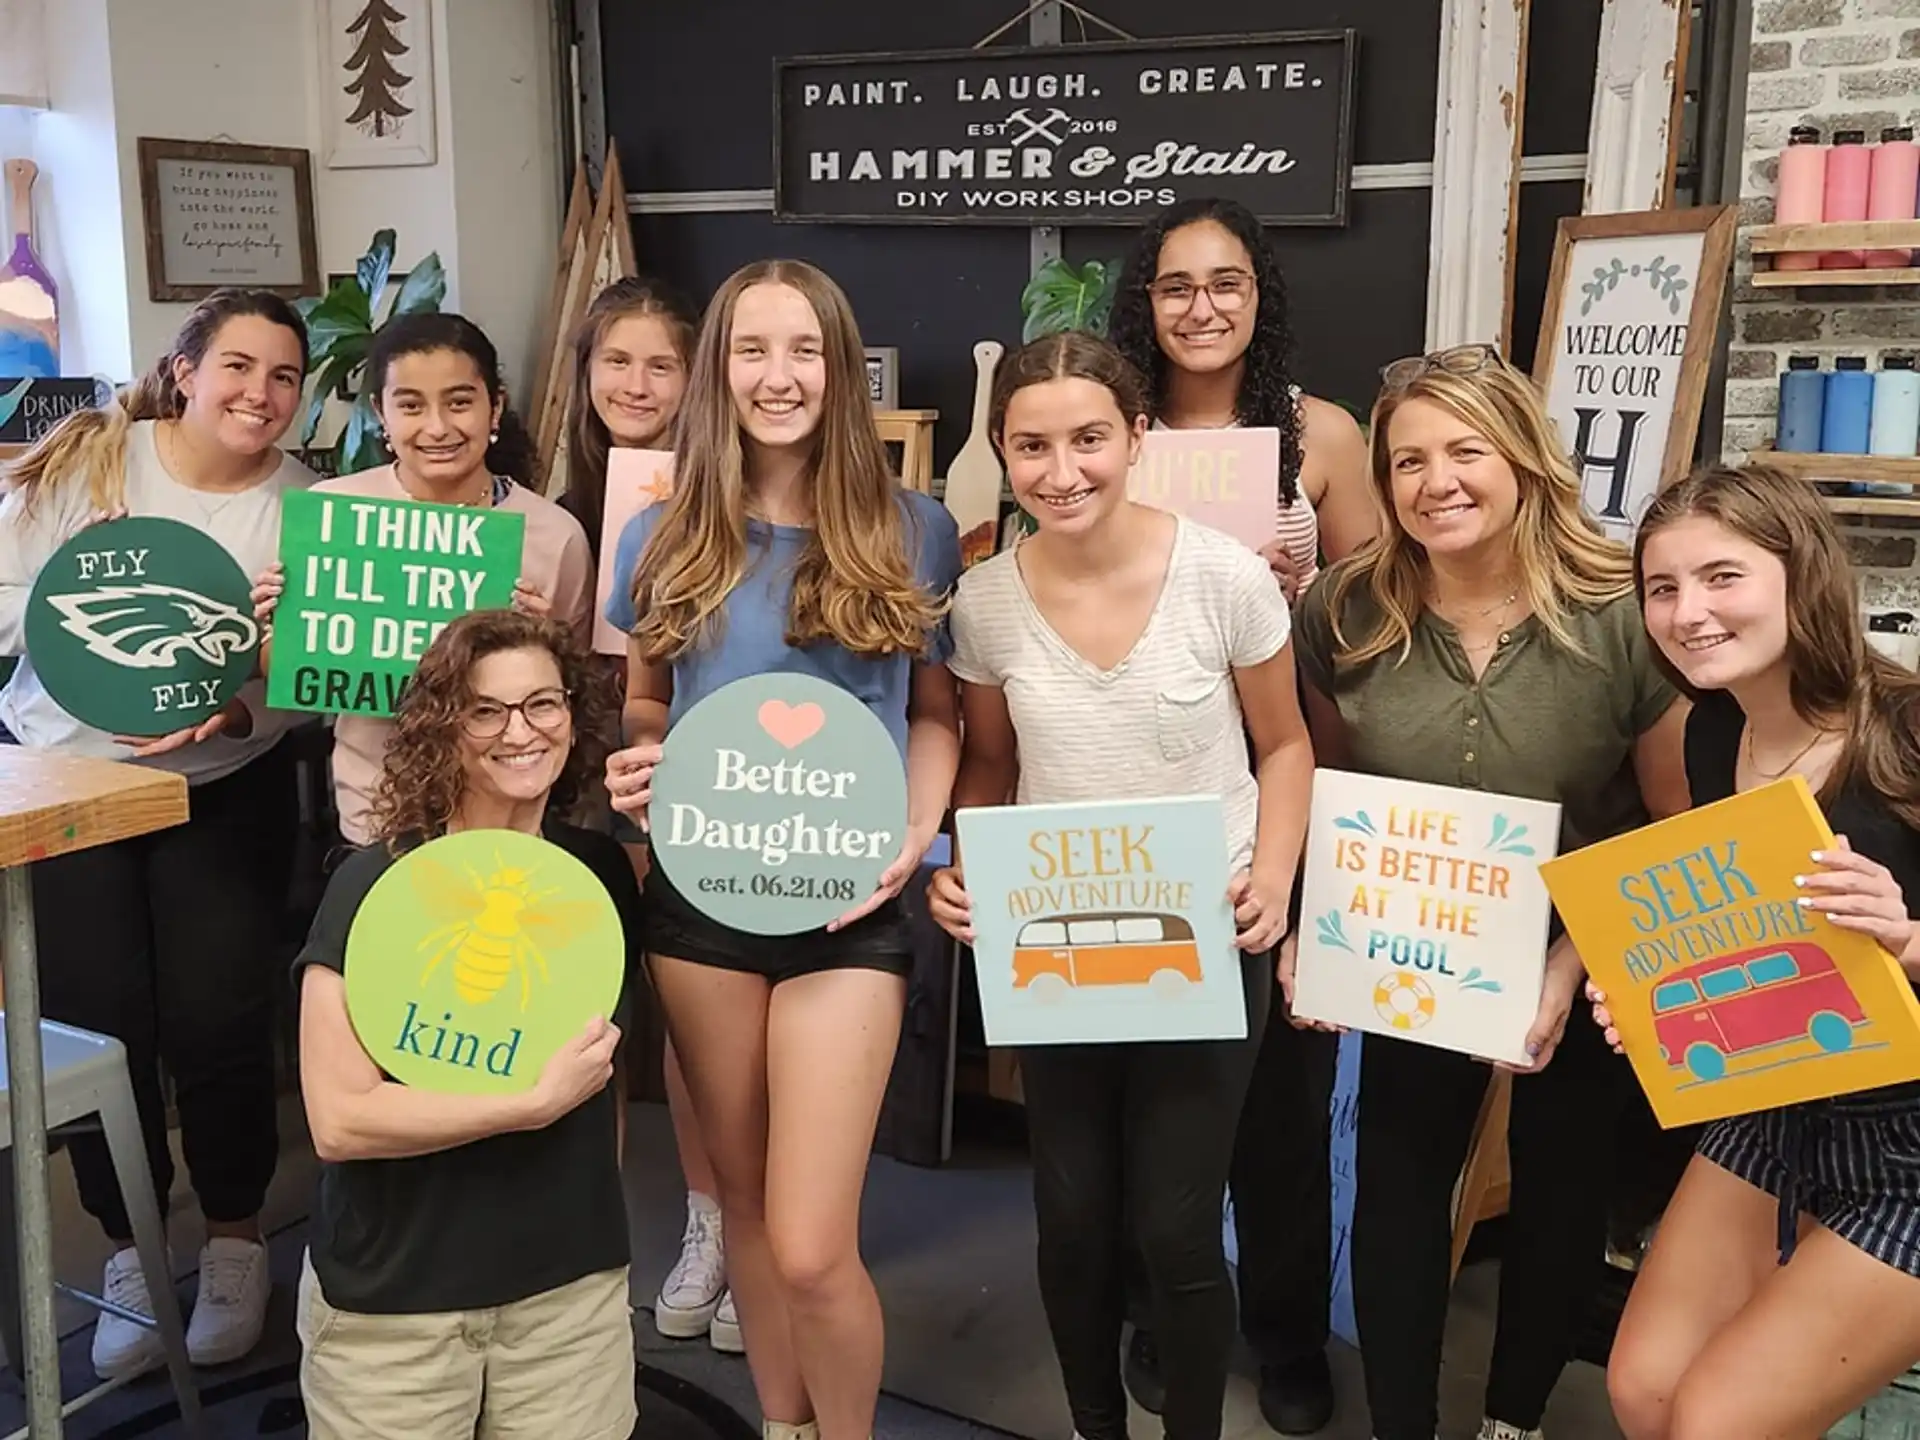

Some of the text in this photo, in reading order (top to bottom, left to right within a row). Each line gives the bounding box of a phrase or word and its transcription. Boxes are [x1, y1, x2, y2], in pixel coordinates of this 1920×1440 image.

[804, 62, 1323, 106] PAINT. LAUGH. CREATE.
[1070, 119, 1119, 134] 2016
[810, 141, 1297, 185] HAMMER & Stain
[897, 188, 1177, 208] DIY WORKSHOPS
[1566, 323, 1689, 357] WELCOME
[1574, 364, 1662, 398] TO OUR
[23, 394, 93, 418] DRINK
[320, 500, 486, 557] I THINK
[76, 548, 150, 580] FLY
[304, 555, 487, 611] I'LL TRY
[300, 610, 357, 656] TO
[151, 679, 223, 712] FLY
[712, 748, 857, 799] Better
[666, 803, 892, 867] Daughter
[1387, 805, 1461, 846] LIFE
[1028, 824, 1155, 882] SEEK
[1334, 837, 1511, 899] IS BETTER
[697, 873, 857, 901] est. 06.21.08
[1007, 881, 1194, 920] ADVENTURE
[1618, 840, 1761, 934] SEEK
[1348, 883, 1481, 938] AT THE
[1367, 929, 1456, 976] POOL
[1622, 898, 1817, 985] ADVENTURE
[393, 1001, 523, 1077] kind
